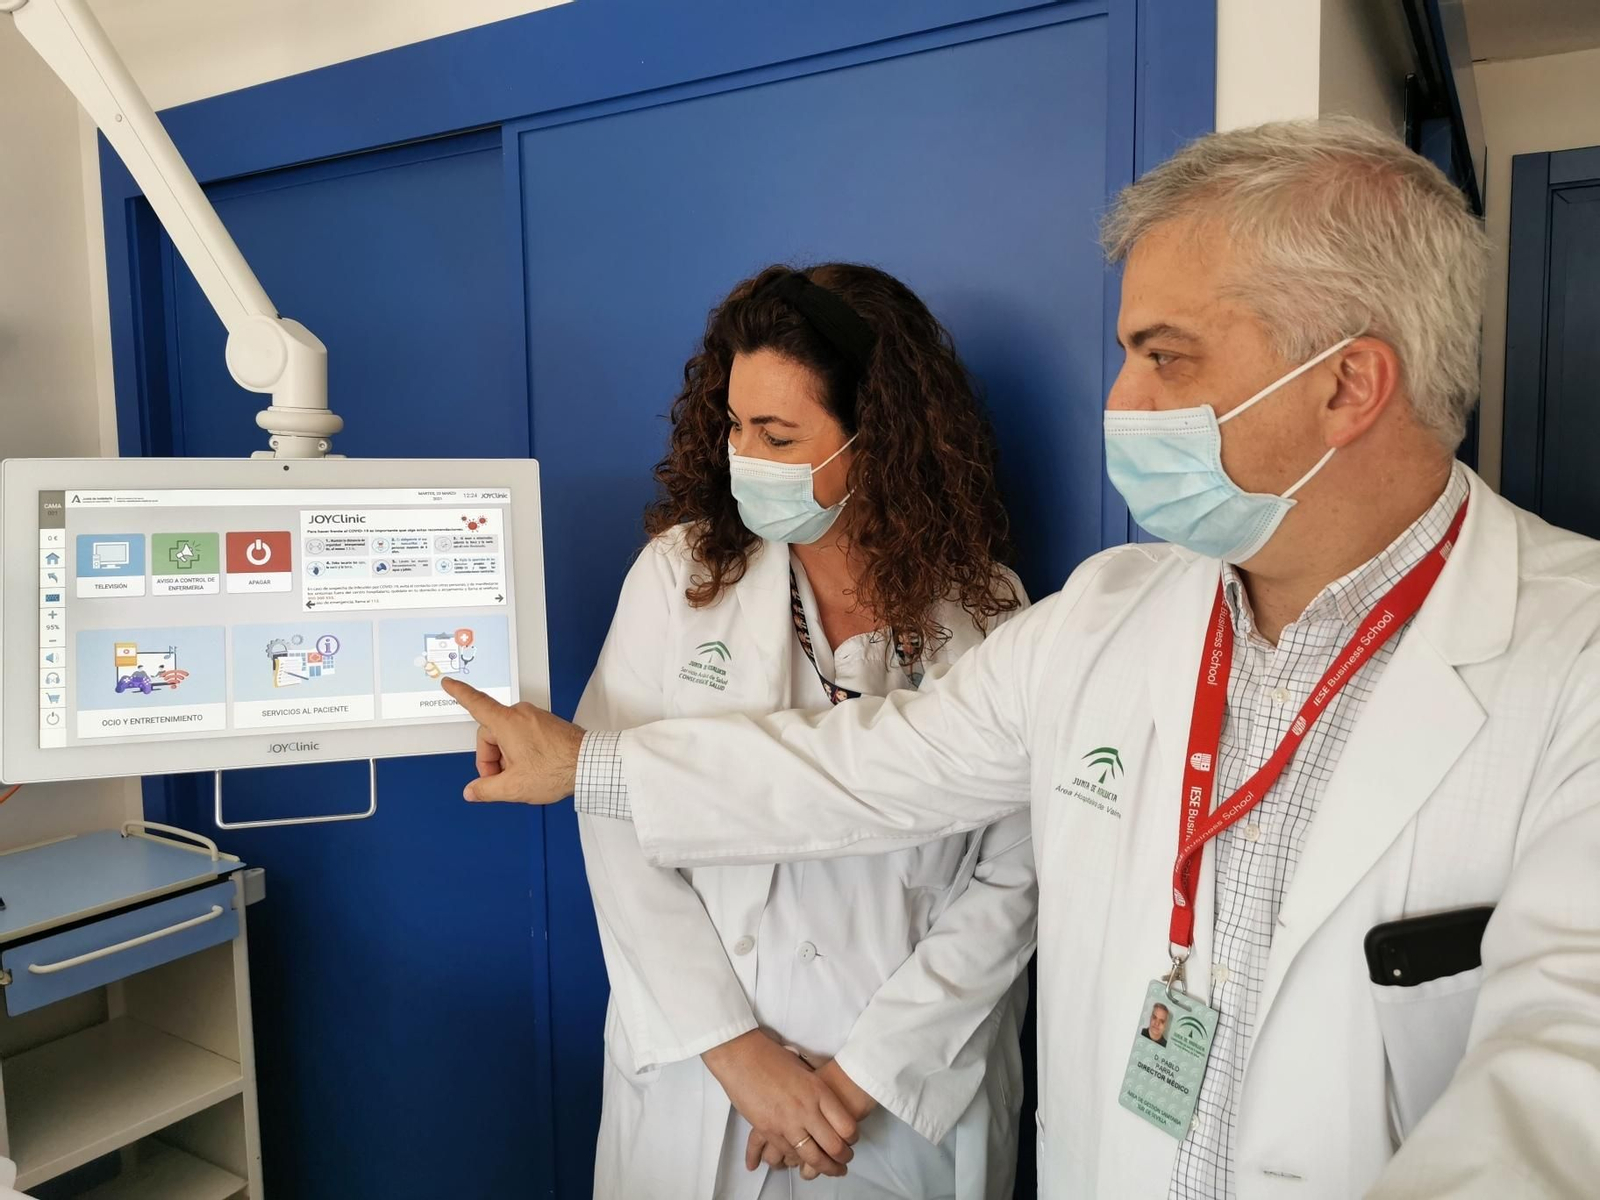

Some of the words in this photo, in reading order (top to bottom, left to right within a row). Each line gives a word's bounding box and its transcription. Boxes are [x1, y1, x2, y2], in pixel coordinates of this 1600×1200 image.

[308, 514, 366, 524] JOYClinic
[1214, 608, 1228, 648] Business
[1313, 687, 1330, 707] IESE
[1329, 646, 1364, 688] Business
[1360, 609, 1395, 646] School
[1207, 650, 1223, 686] School
[420, 699, 460, 707] PROFESION
[262, 708, 300, 717] SERVICIOS
[313, 706, 349, 714] PACIENTE
[102, 718, 122, 726] OCIO
[130, 714, 203, 725] ENTRETENIMIENTO
[266, 741, 320, 753] JOYClinic
[1189, 786, 1202, 808] IESE
[1222, 790, 1254, 820] School
[1156, 1063, 1174, 1078] PARRA
[1162, 1058, 1180, 1072] PABLO
[1137, 1061, 1166, 1081] DIRECTOR
[1167, 1077, 1190, 1094] MÉDICO
